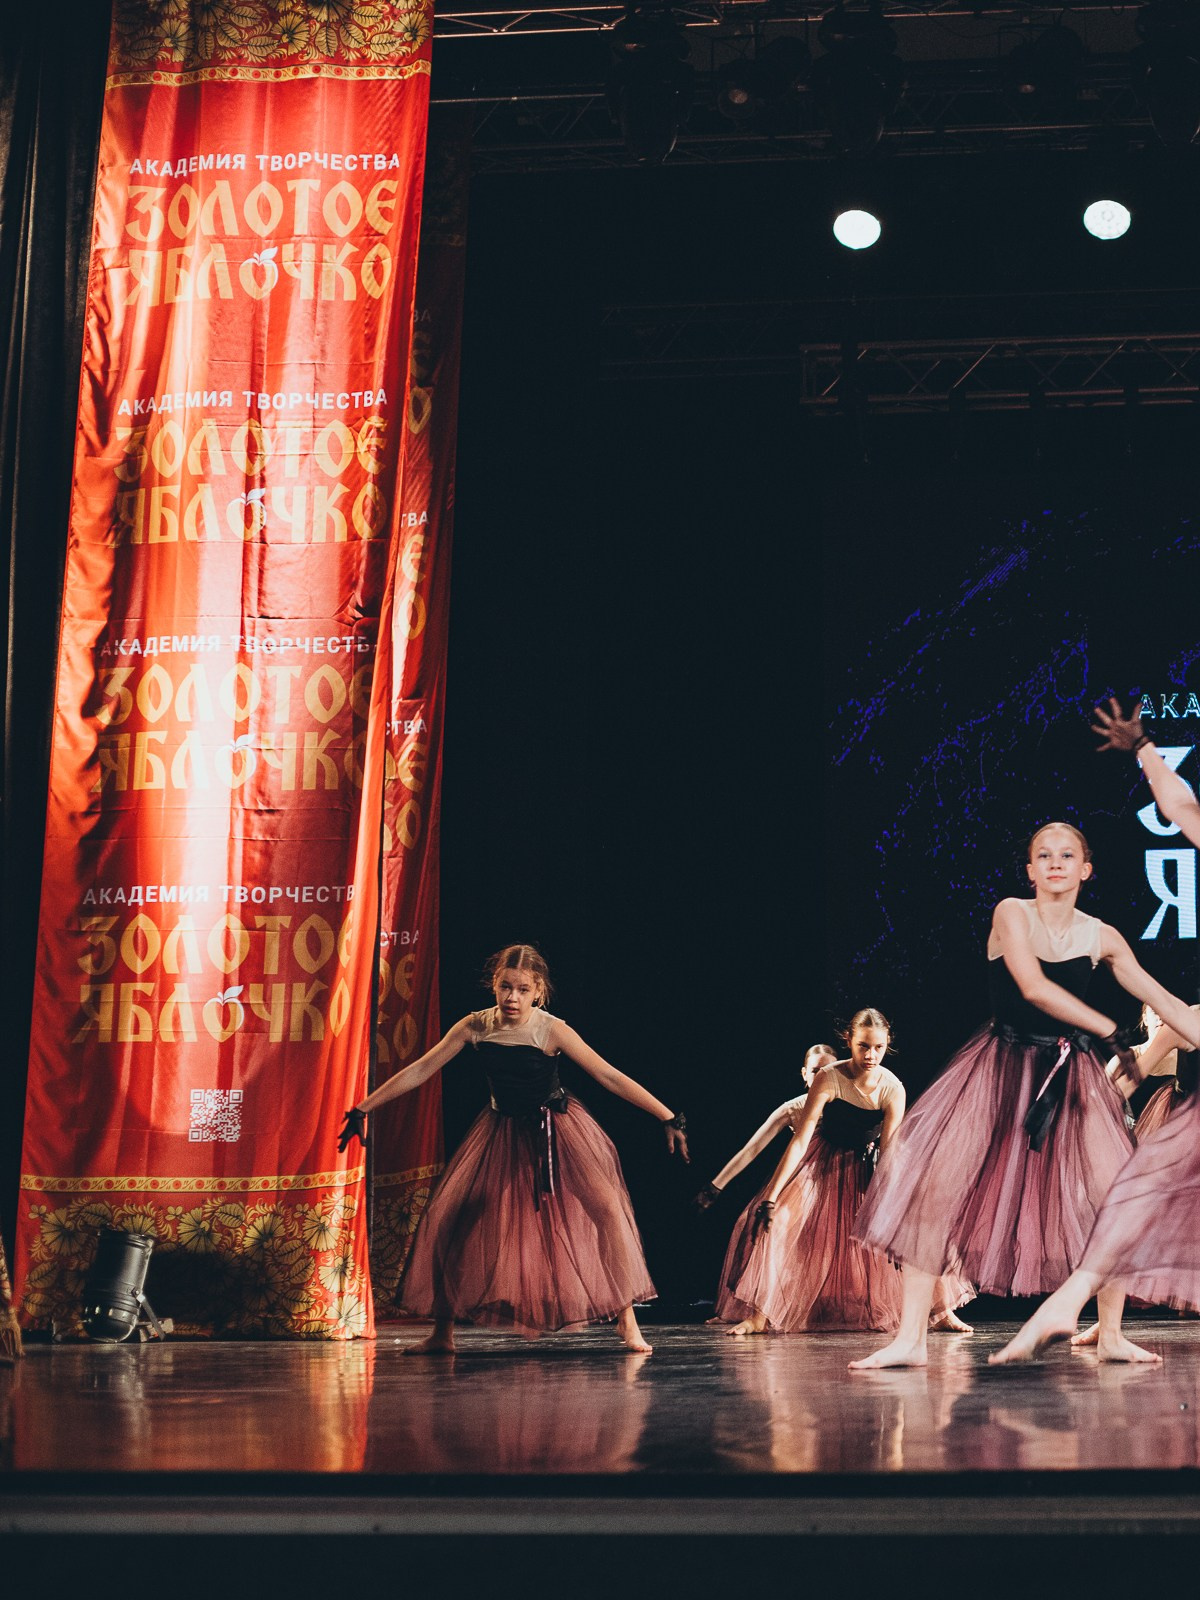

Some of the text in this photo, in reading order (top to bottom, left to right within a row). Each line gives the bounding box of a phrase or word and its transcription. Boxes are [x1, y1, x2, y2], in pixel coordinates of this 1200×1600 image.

[130, 151, 400, 178] АКАДЕМИЯ ТВОРЧЕСТВА
[122, 242, 393, 307] ЯБЛОЧКО
[117, 388, 388, 416] АКАДЕМИЯ ТВОРЧЕСТВА
[100, 634, 377, 657] АКАДЕМИЯ ТВОРЧЕСТВ
[83, 884, 209, 907] АКАДЕМИЯ
